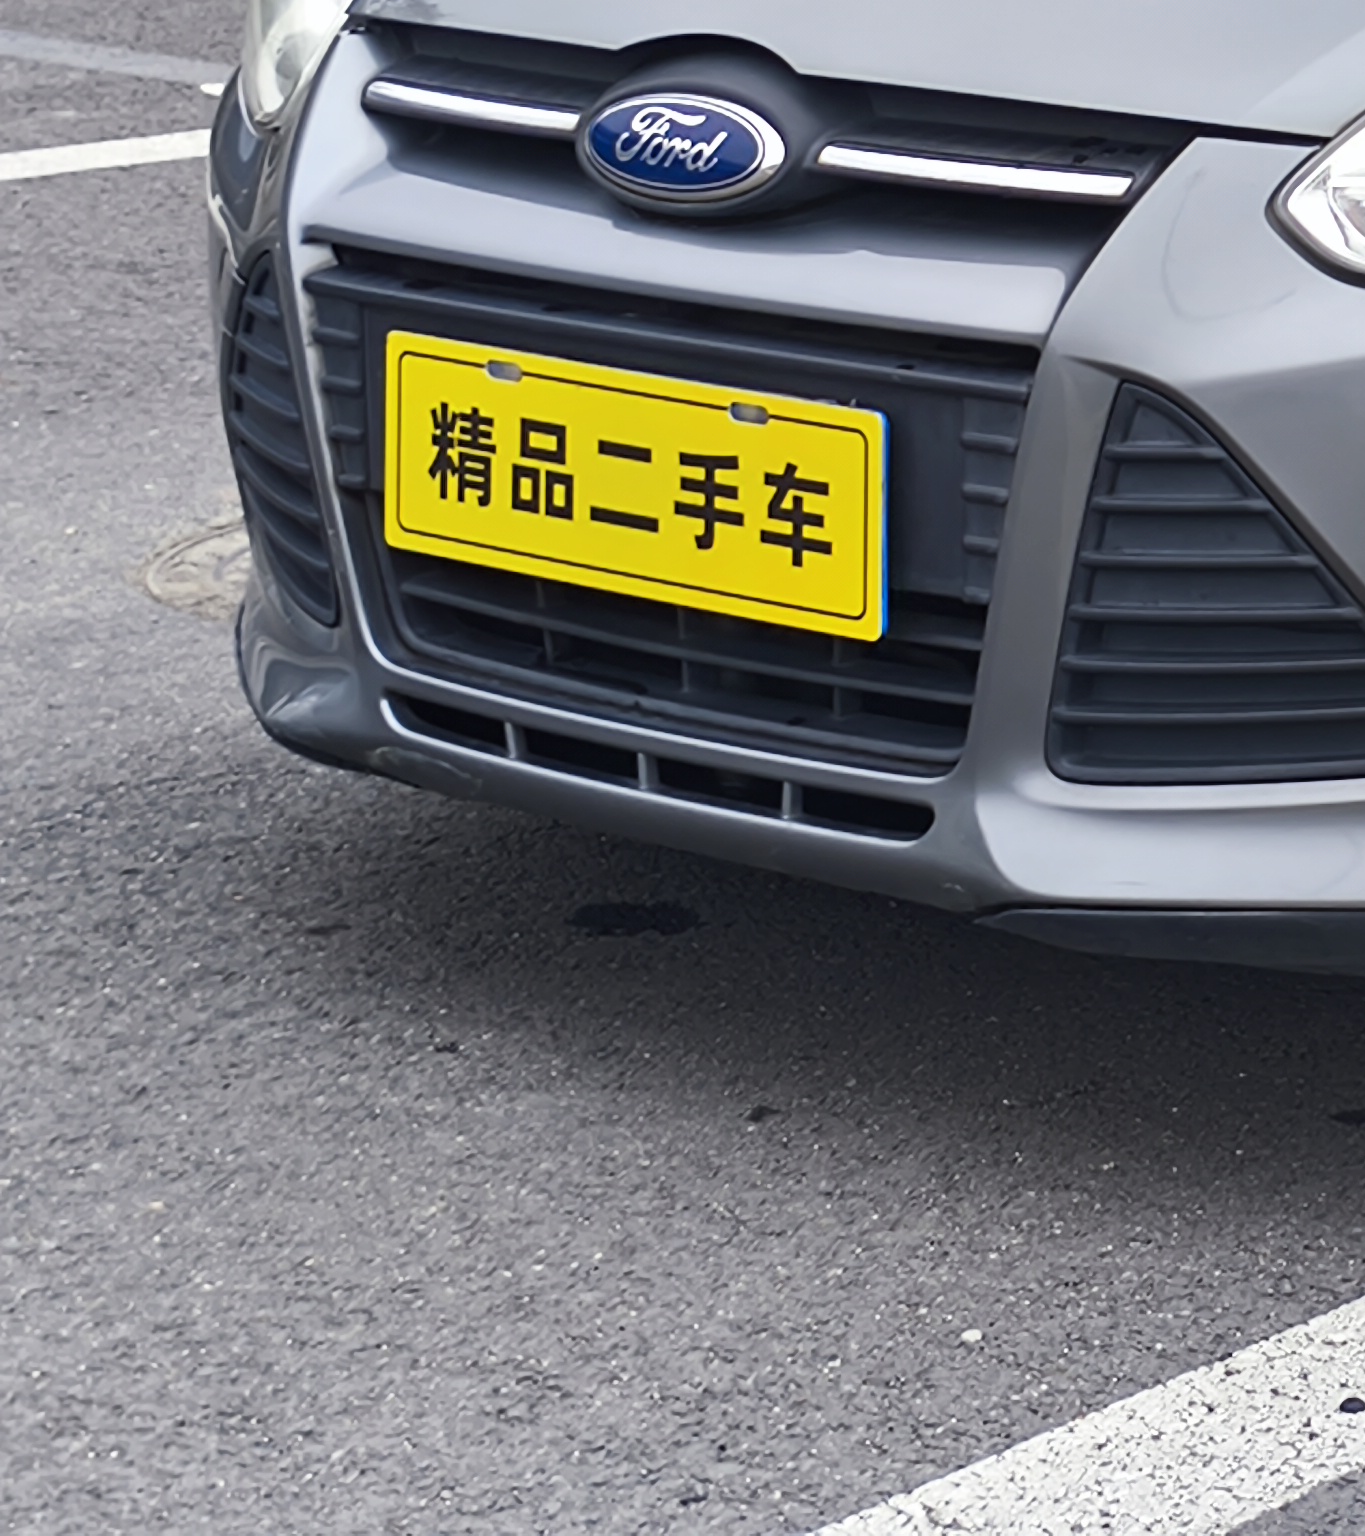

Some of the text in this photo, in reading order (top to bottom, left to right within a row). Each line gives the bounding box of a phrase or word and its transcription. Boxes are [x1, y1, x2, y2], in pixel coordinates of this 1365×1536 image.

[615, 106, 728, 172] Ford
[428, 401, 833, 568] 精品二手车
